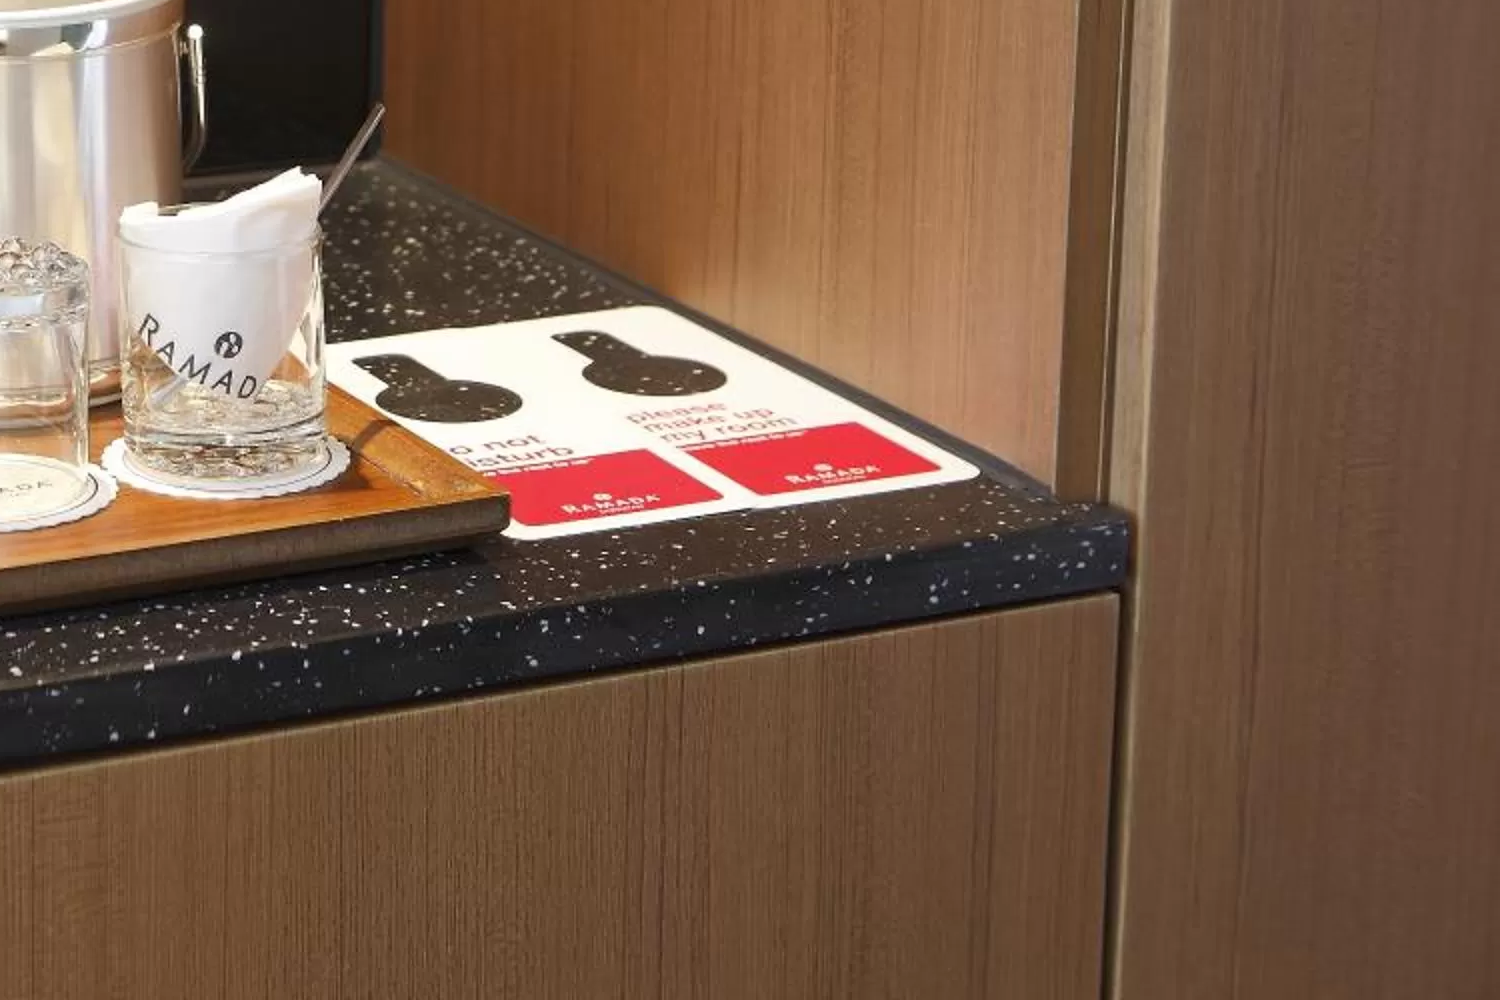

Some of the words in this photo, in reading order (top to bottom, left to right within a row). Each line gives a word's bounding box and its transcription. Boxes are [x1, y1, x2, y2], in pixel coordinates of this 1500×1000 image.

[138, 312, 258, 399] RAMAD
[626, 403, 727, 424] please
[643, 415, 726, 432] make
[732, 408, 775, 419] up
[659, 429, 706, 442] my
[716, 416, 798, 434] room
[483, 434, 548, 450] not
[466, 446, 575, 468] isturb
[783, 464, 882, 485] RAMADA
[560, 494, 661, 515] RAMADA
